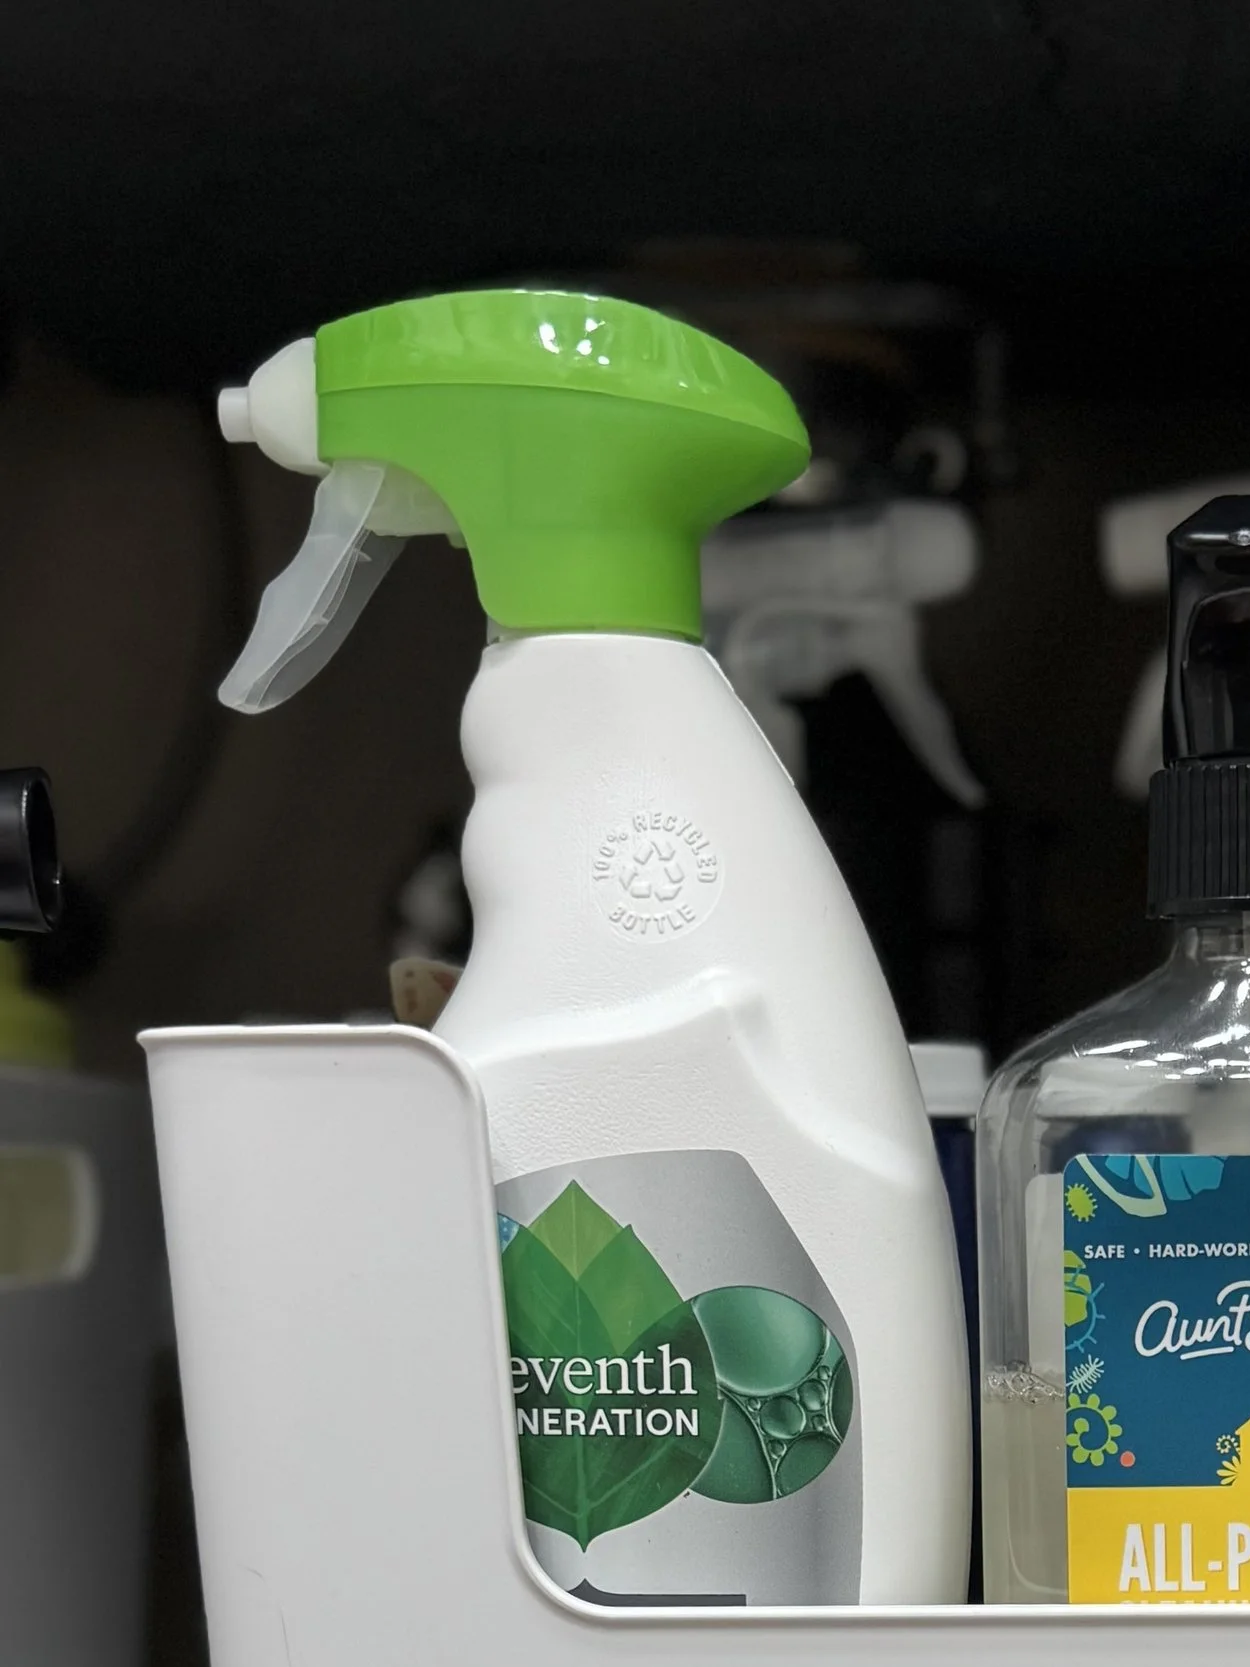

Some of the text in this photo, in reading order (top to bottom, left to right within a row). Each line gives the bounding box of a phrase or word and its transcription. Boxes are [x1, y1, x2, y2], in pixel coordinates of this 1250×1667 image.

[632, 812, 718, 884] RECYCLED
[608, 904, 697, 935] BOTTLE
[1084, 1244, 1125, 1259] SAFE
[510, 1343, 698, 1395] eventh
[517, 1408, 699, 1436] NERATION
